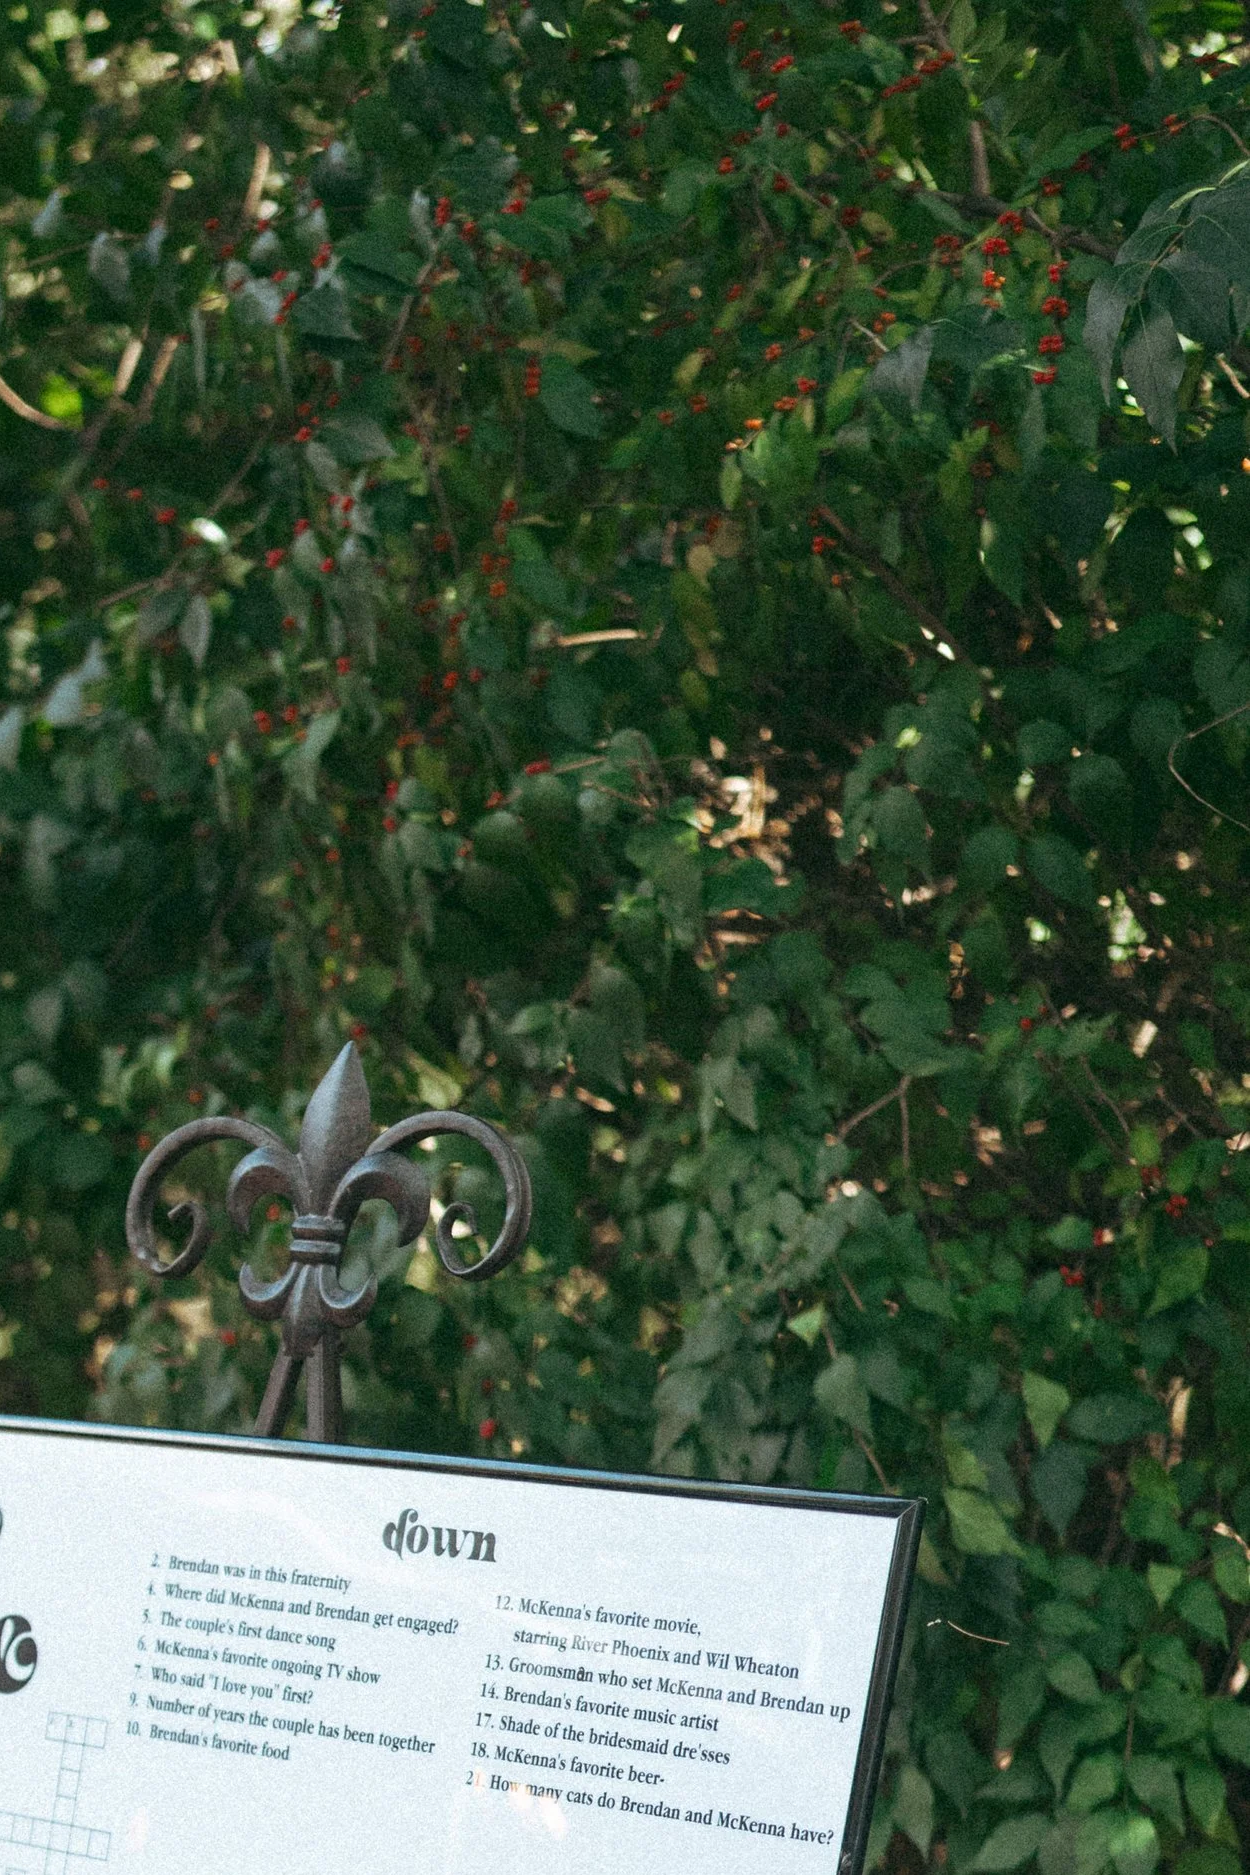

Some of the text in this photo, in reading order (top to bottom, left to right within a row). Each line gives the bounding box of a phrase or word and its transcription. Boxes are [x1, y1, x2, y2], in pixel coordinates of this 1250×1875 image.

[382, 1508, 496, 1562] down
[168, 1555, 219, 1574] Brendan
[223, 1565, 245, 1577] was
[249, 1565, 261, 1580] in
[264, 1566, 287, 1583] this
[290, 1569, 351, 1594] fraternity
[164, 1583, 202, 1601] Where
[205, 1588, 226, 1604] did
[229, 1592, 285, 1612] McKenna
[287, 1600, 312, 1615] and
[315, 1602, 370, 1623] Brendan
[372, 1613, 394, 1628] get
[396, 1616, 459, 1635] engaged?
[495, 1595, 701, 1636] 12. McKenna's favorite movie,
[161, 1611, 182, 1627] The
[185, 1618, 234, 1635] couple's
[237, 1621, 262, 1638] first
[265, 1626, 303, 1644] dance
[305, 1635, 336, 1652] song
[155, 1639, 218, 1660] McKenna's
[221, 1648, 268, 1668] favorite
[271, 1659, 323, 1679] ongoing
[327, 1662, 344, 1678] TV
[345, 1666, 381, 1683] show
[513, 1630, 799, 1679] starring River Phoenix and Wil Wheaton
[151, 1666, 177, 1684] Who
[180, 1673, 205, 1688] said
[221, 1677, 247, 1694] love
[282, 1686, 313, 1704] first?
[485, 1654, 504, 1670] 13.
[597, 1670, 628, 1687] who
[631, 1677, 653, 1691] set
[655, 1677, 723, 1700] McKenna
[726, 1690, 756, 1705] and
[759, 1692, 824, 1714] Brendan
[829, 1705, 851, 1722] up
[129, 1692, 436, 1753] 9. Number of years the couple has been together
[480, 1683, 719, 1732] 14. Brendan's favorite music artist
[149, 1724, 208, 1746] Brendan's
[211, 1734, 258, 1755] favorite
[261, 1741, 290, 1760] food
[475, 1712, 494, 1728] 17.
[498, 1716, 541, 1735] Shade
[543, 1723, 561, 1738] of
[562, 1725, 585, 1742] the
[588, 1729, 669, 1755] bridesmaid
[470, 1741, 489, 1758] 18.
[494, 1746, 566, 1770] McKenna's
[569, 1757, 624, 1779] favorite
[490, 1774, 518, 1792] How
[526, 1784, 562, 1802] many
[565, 1790, 593, 1805] cats
[596, 1792, 616, 1809] do
[619, 1796, 680, 1819] Brendan
[684, 1809, 714, 1825] and
[716, 1812, 785, 1837] McKenna
[789, 1823, 834, 1844] have?
